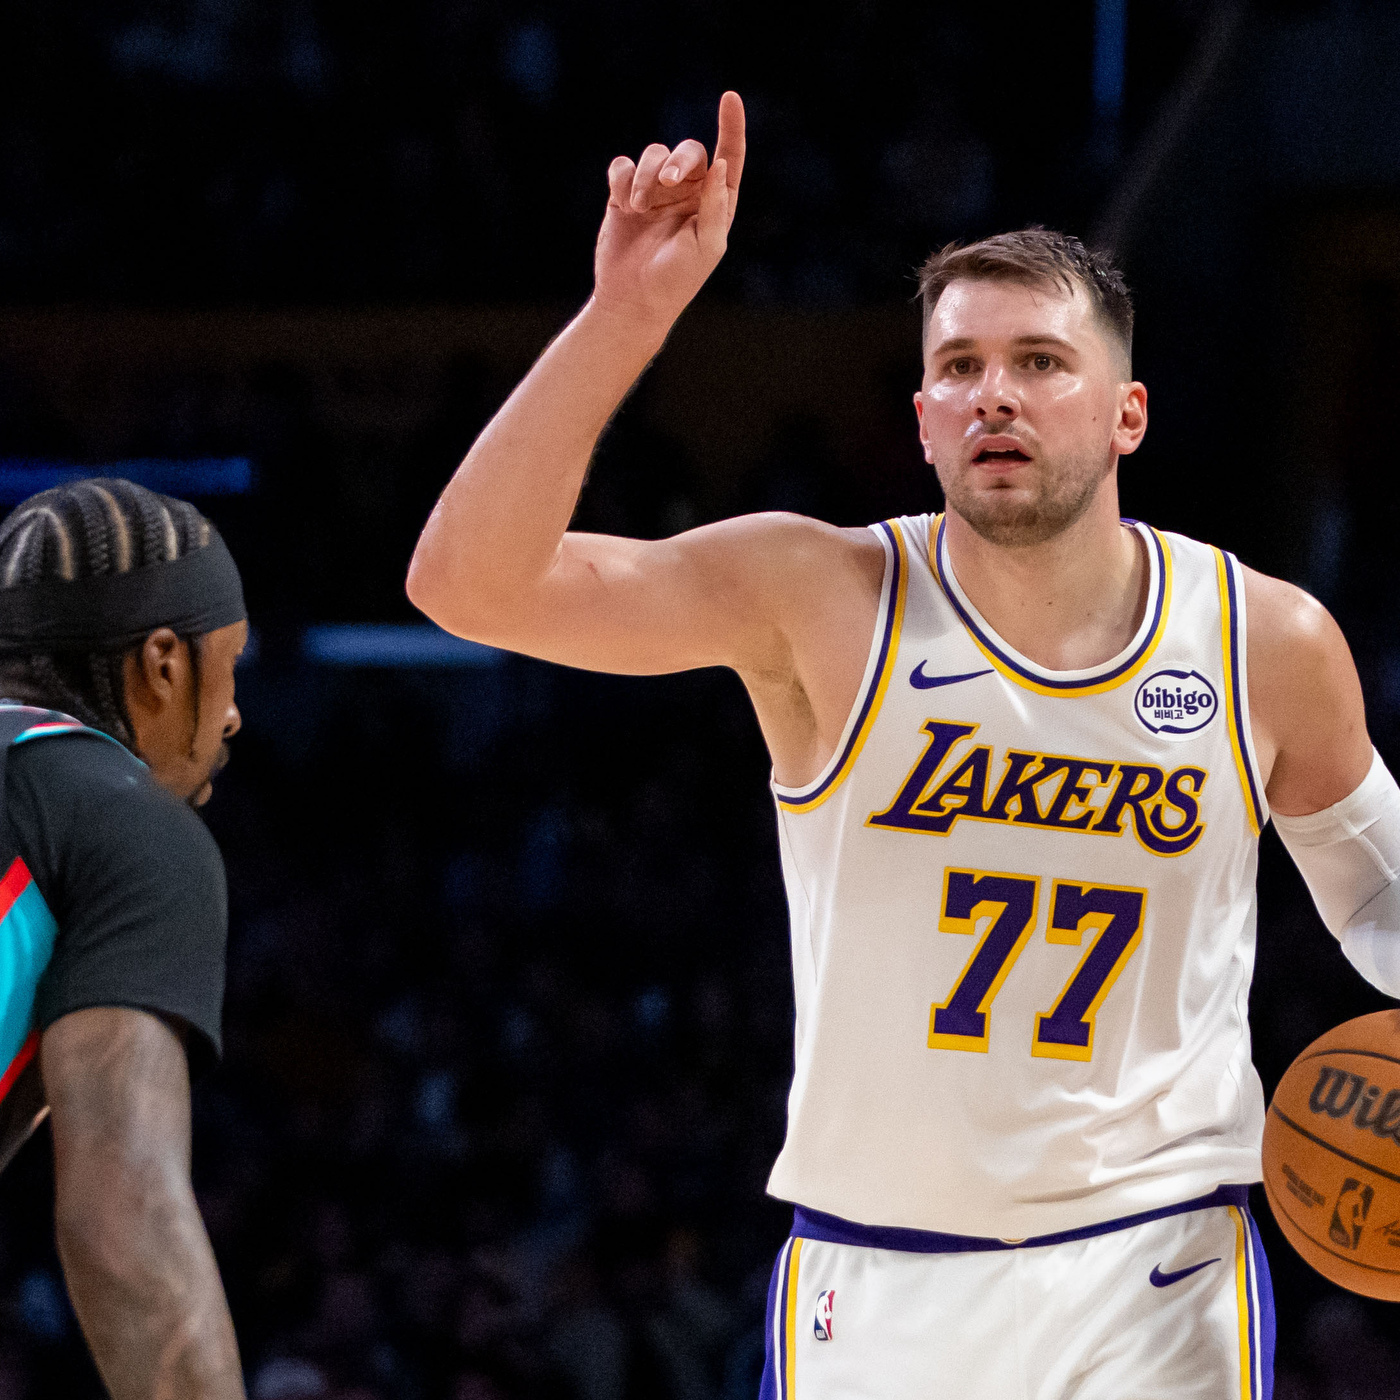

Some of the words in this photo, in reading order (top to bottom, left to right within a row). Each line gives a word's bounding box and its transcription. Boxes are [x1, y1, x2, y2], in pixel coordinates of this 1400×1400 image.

[1142, 686, 1213, 715] bibigo
[1153, 709, 1185, 720] 비비고
[864, 718, 1210, 858] LAKERS
[927, 866, 1148, 1063] 77
